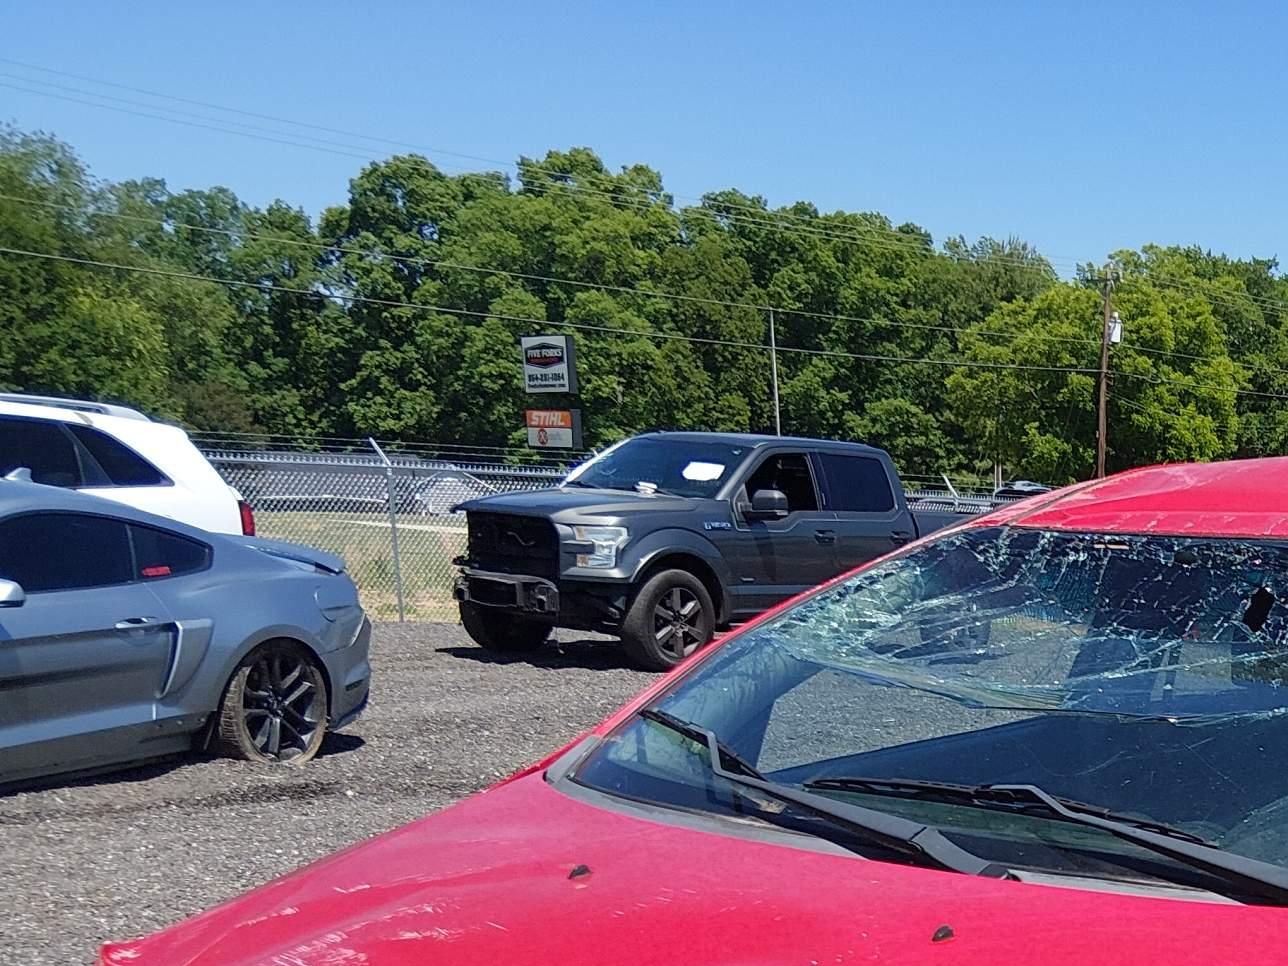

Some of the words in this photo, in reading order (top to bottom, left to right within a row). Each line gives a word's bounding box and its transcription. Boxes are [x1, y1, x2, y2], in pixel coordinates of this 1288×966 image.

[527, 349, 541, 358] FIVE
[541, 348, 562, 358] FORKS
[531, 411, 565, 426] STIHL
